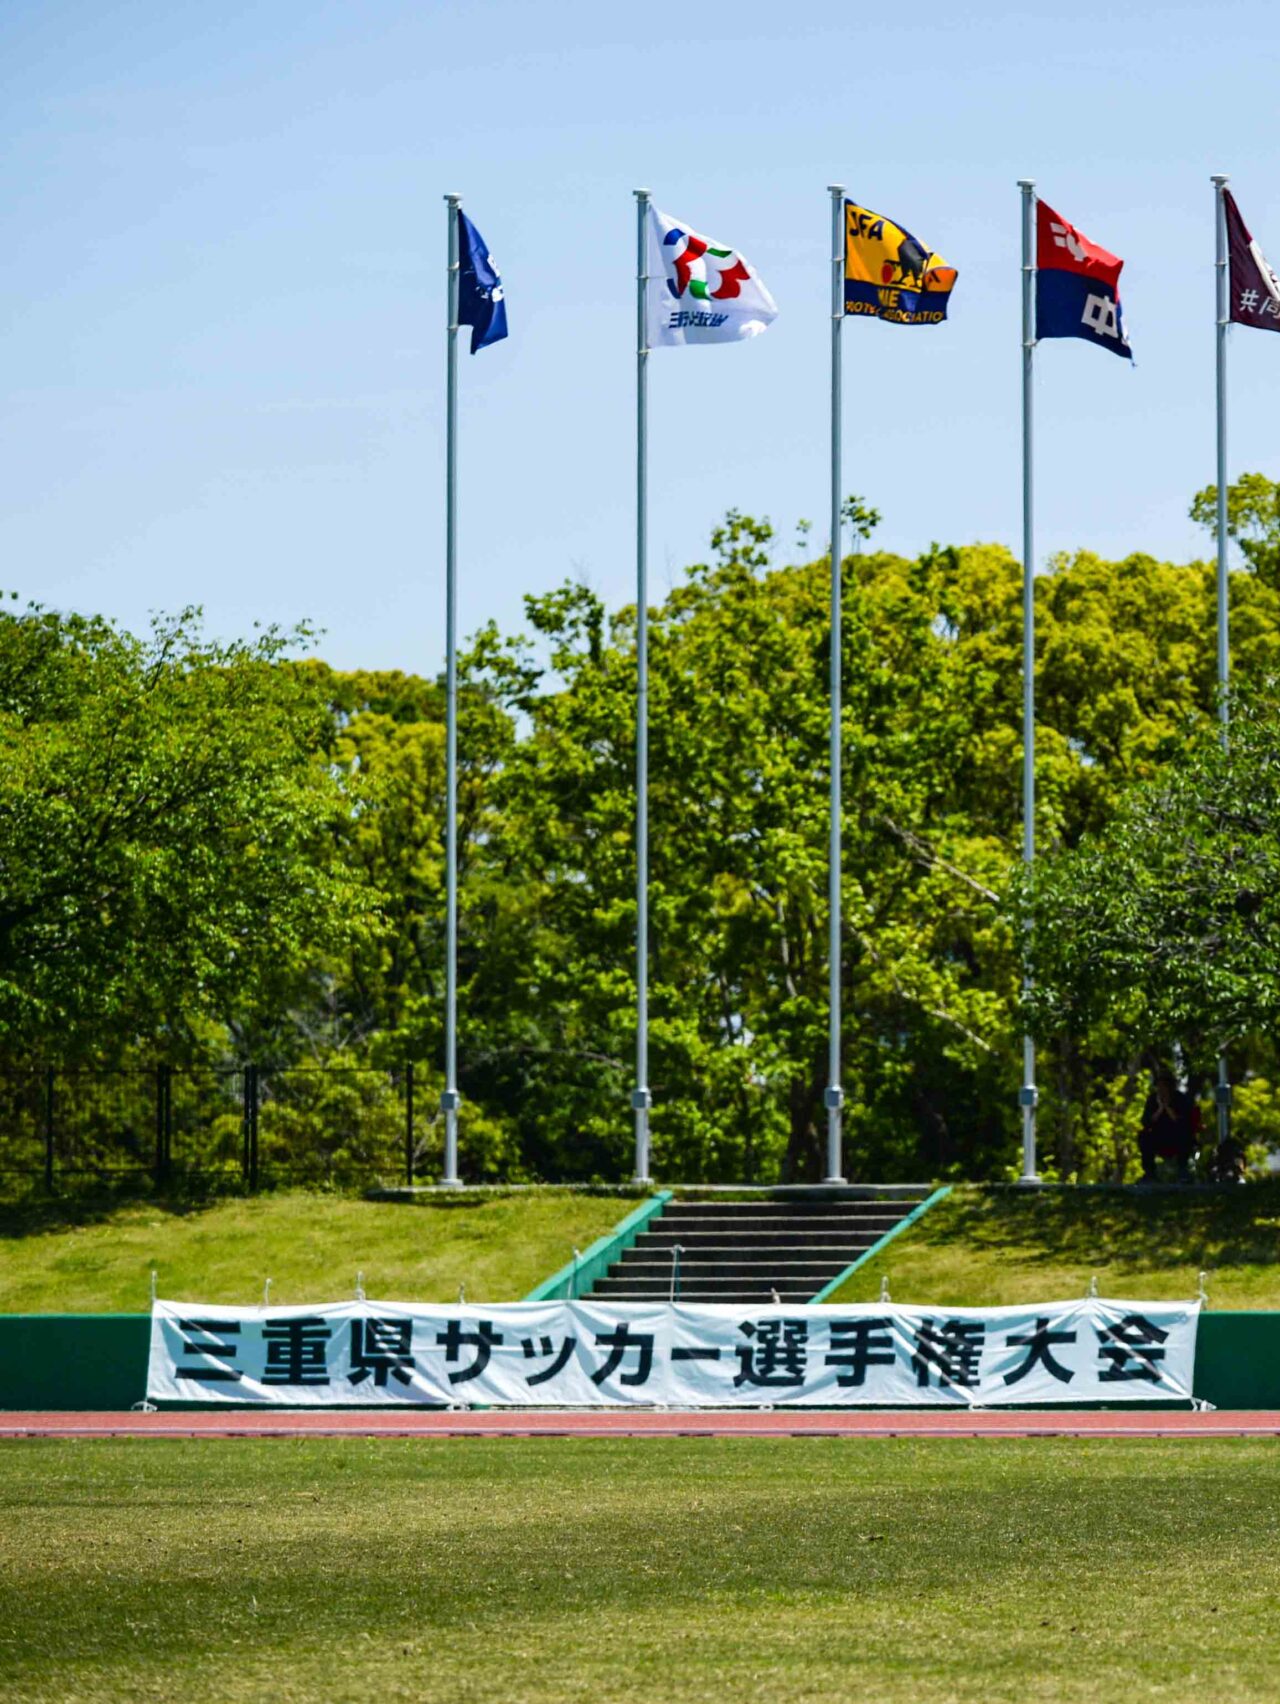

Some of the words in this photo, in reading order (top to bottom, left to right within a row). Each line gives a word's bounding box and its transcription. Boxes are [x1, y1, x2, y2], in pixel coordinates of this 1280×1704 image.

[850, 211, 884, 241] JFA
[175, 1315, 1170, 1386] 三重県サッカー選手権大会
